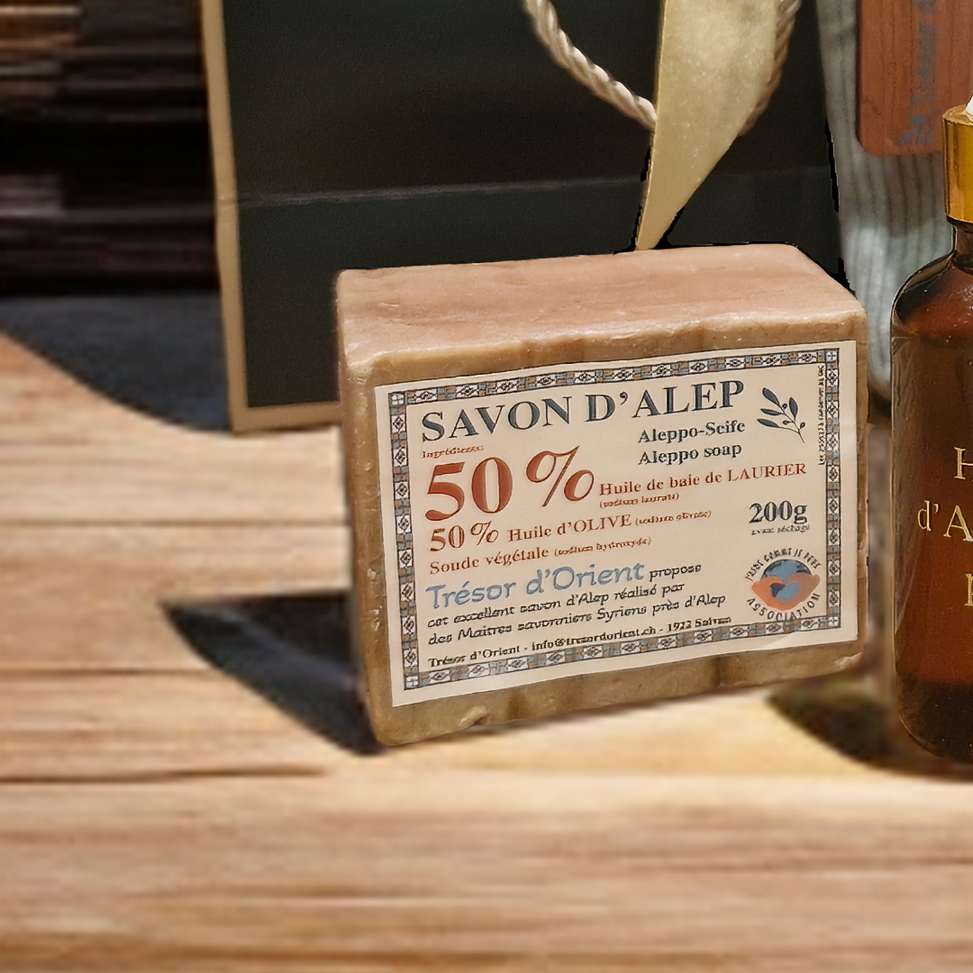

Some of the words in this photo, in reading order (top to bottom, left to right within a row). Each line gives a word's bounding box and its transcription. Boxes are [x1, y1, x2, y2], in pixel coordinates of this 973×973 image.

[422, 396, 572, 442] SAVON
[585, 380, 744, 422] D'ALEP
[638, 420, 746, 443] Aleppo-Seife
[638, 449, 699, 465] Aleppo
[704, 443, 742, 459] soap
[600, 481, 642, 496] Huile
[646, 478, 664, 491] de
[670, 473, 701, 488] baie
[705, 469, 723, 484] de
[728, 463, 807, 482] LAURIER
[749, 500, 808, 525] 200g
[508, 527, 551, 543] Huile
[557, 514, 632, 535] d'OLIVE
[430, 555, 479, 575] Soude
[485, 547, 549, 567] végétale
[425, 580, 517, 609] Trésor
[526, 563, 645, 595] d'Orient
[649, 564, 702, 582] propose
[453, 606, 515, 624] excellent
[520, 600, 561, 613] savon
[566, 591, 609, 608] d'Alep
[614, 584, 657, 600] réalisé
[661, 583, 685, 597] par
[428, 633, 453, 645] des
[518, 614, 592, 631] savonniers
[597, 605, 647, 623] Syriens
[652, 600, 680, 616] près
[684, 593, 727, 608] d'Alep
[470, 646, 520, 661] d'Orient
